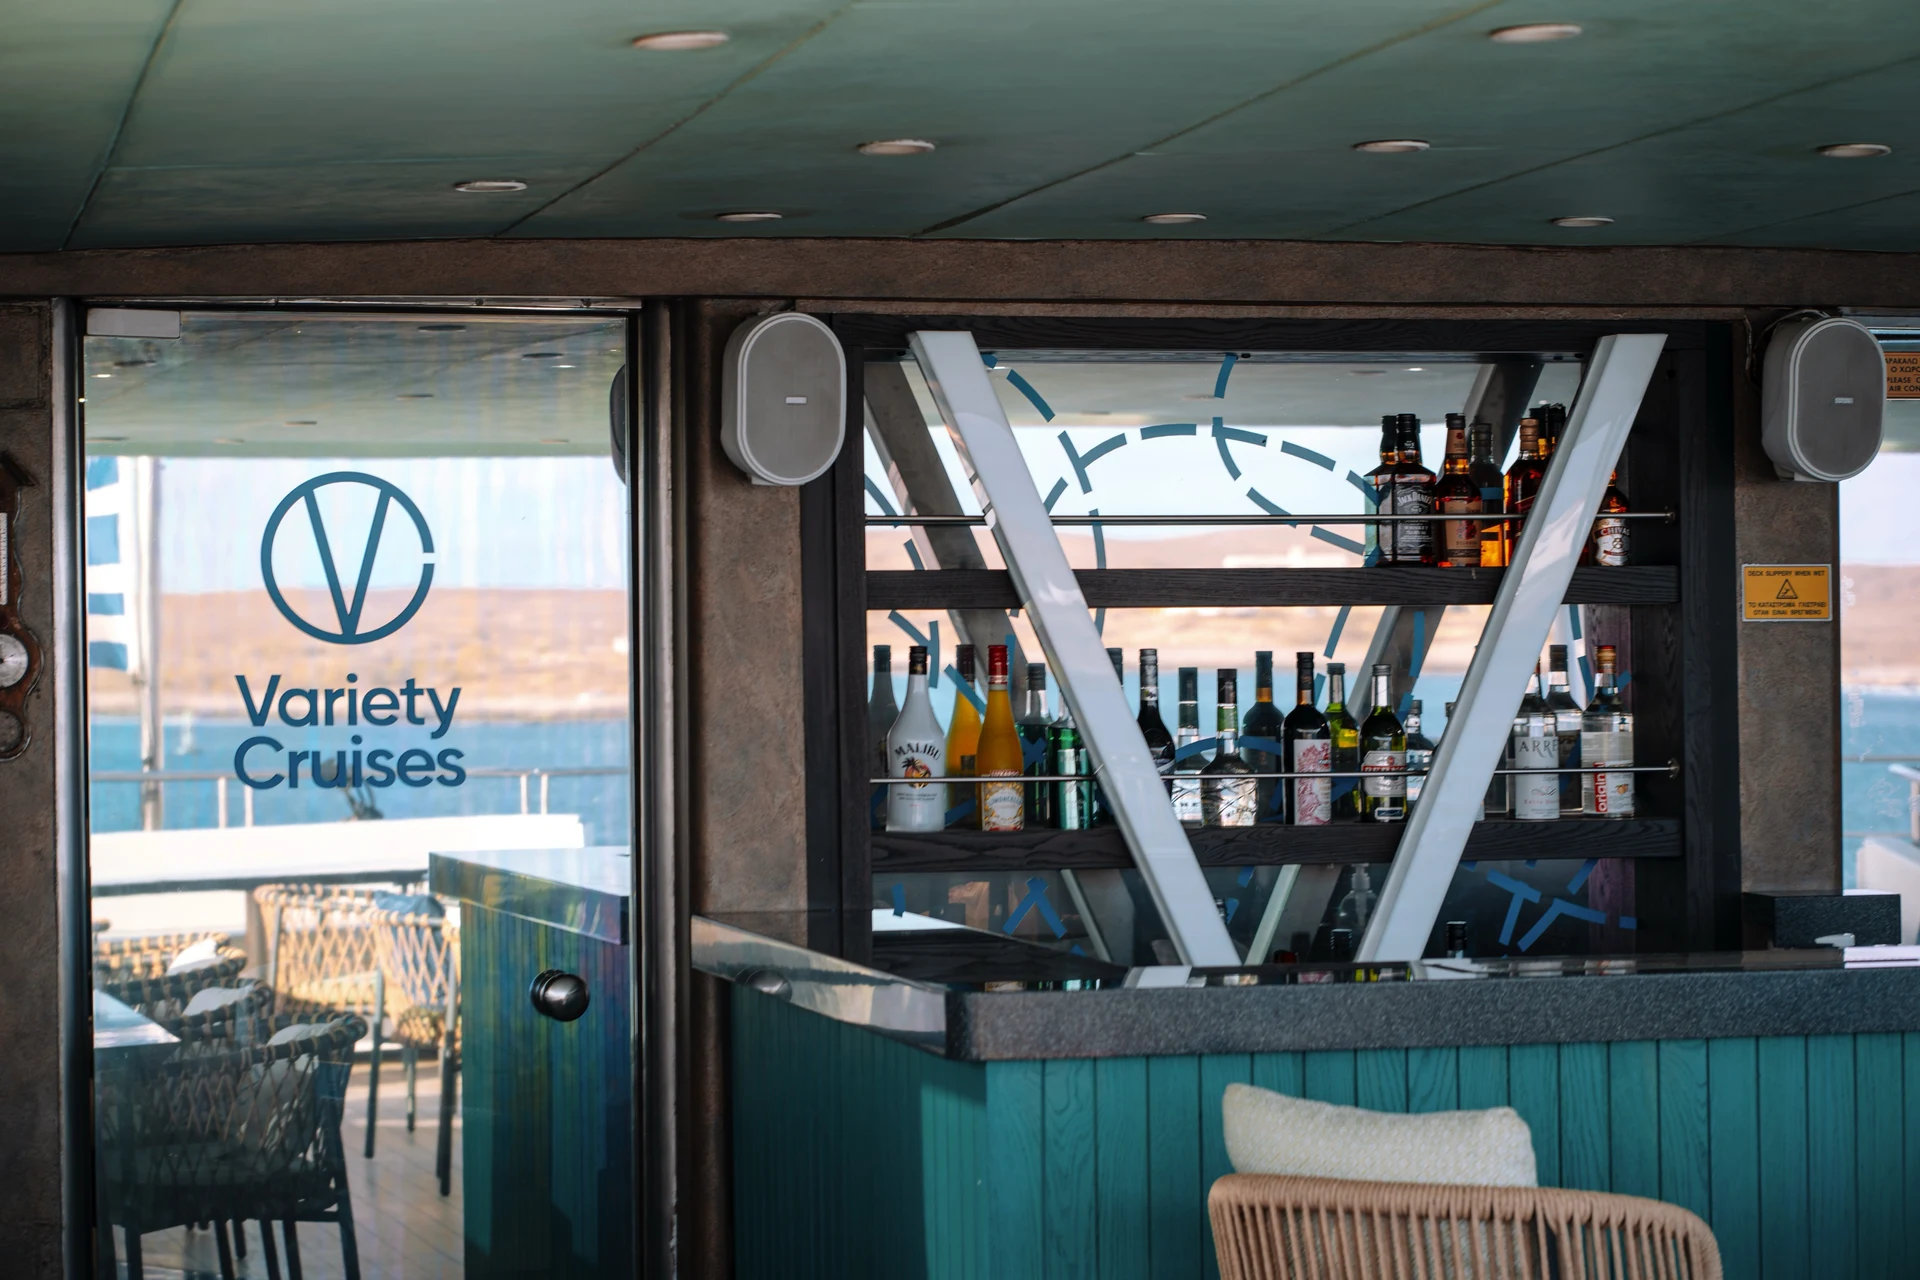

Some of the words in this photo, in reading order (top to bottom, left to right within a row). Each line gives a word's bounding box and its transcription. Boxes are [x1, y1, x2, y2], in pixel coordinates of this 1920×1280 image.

[235, 673, 462, 740] Variety
[234, 735, 467, 790] Cruises
[894, 742, 942, 760] MALIBU
